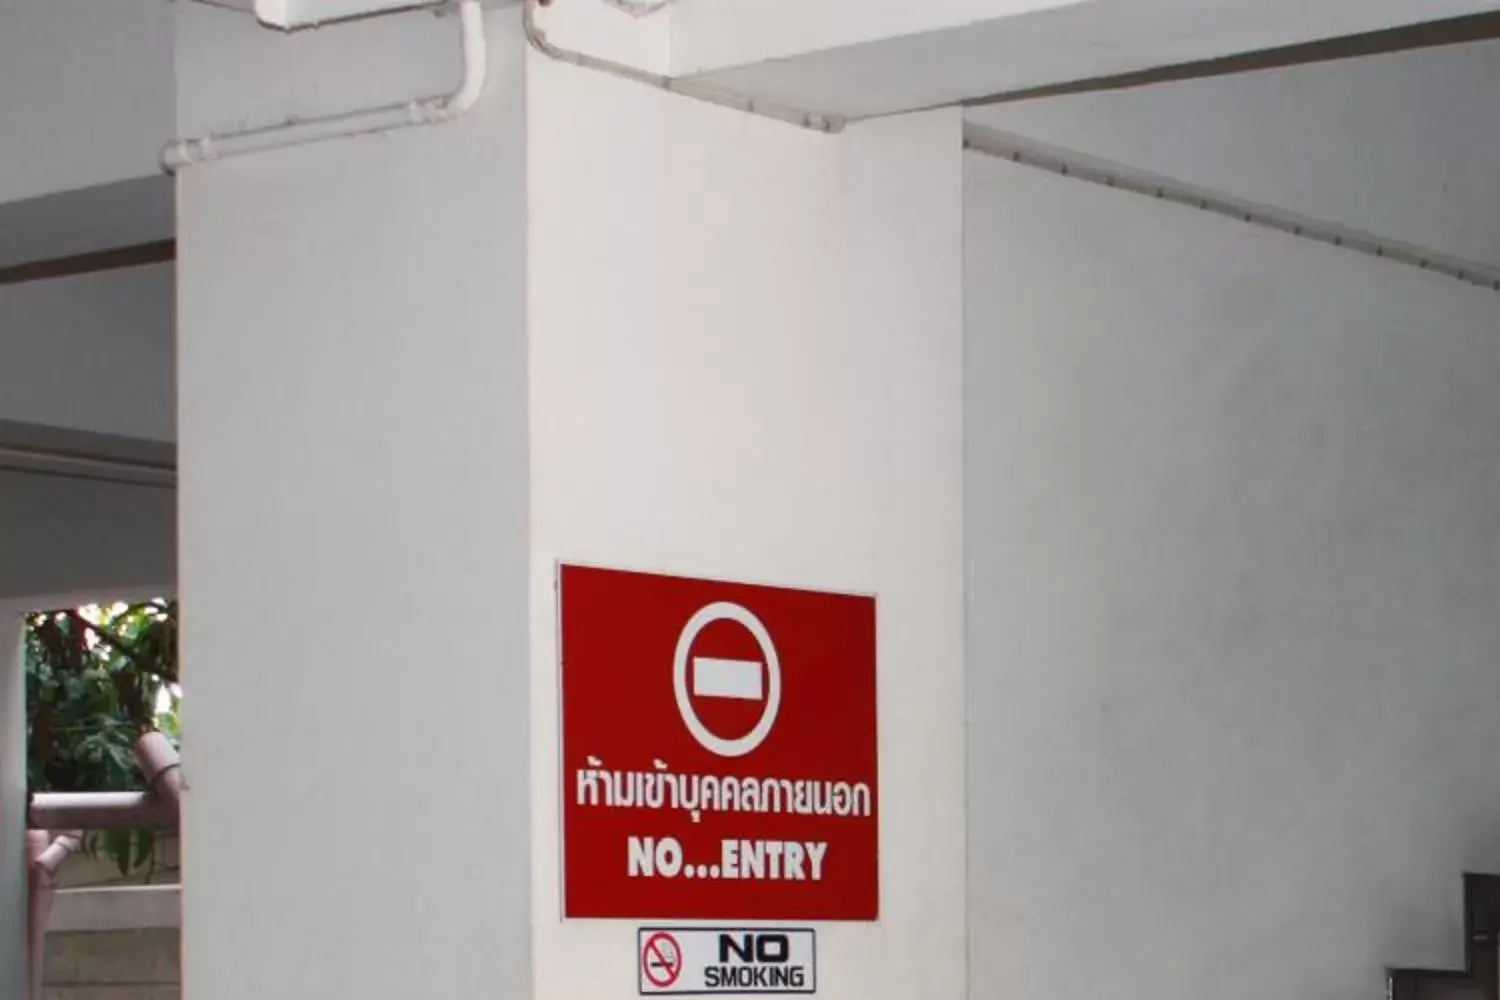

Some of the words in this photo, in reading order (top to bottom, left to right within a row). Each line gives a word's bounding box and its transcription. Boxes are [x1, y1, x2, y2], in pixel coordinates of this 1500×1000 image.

[576, 756, 871, 822] ห้ามเข้าบุคคลภายนอก
[719, 933, 789, 964] NO
[704, 966, 804, 988] SMOKING
